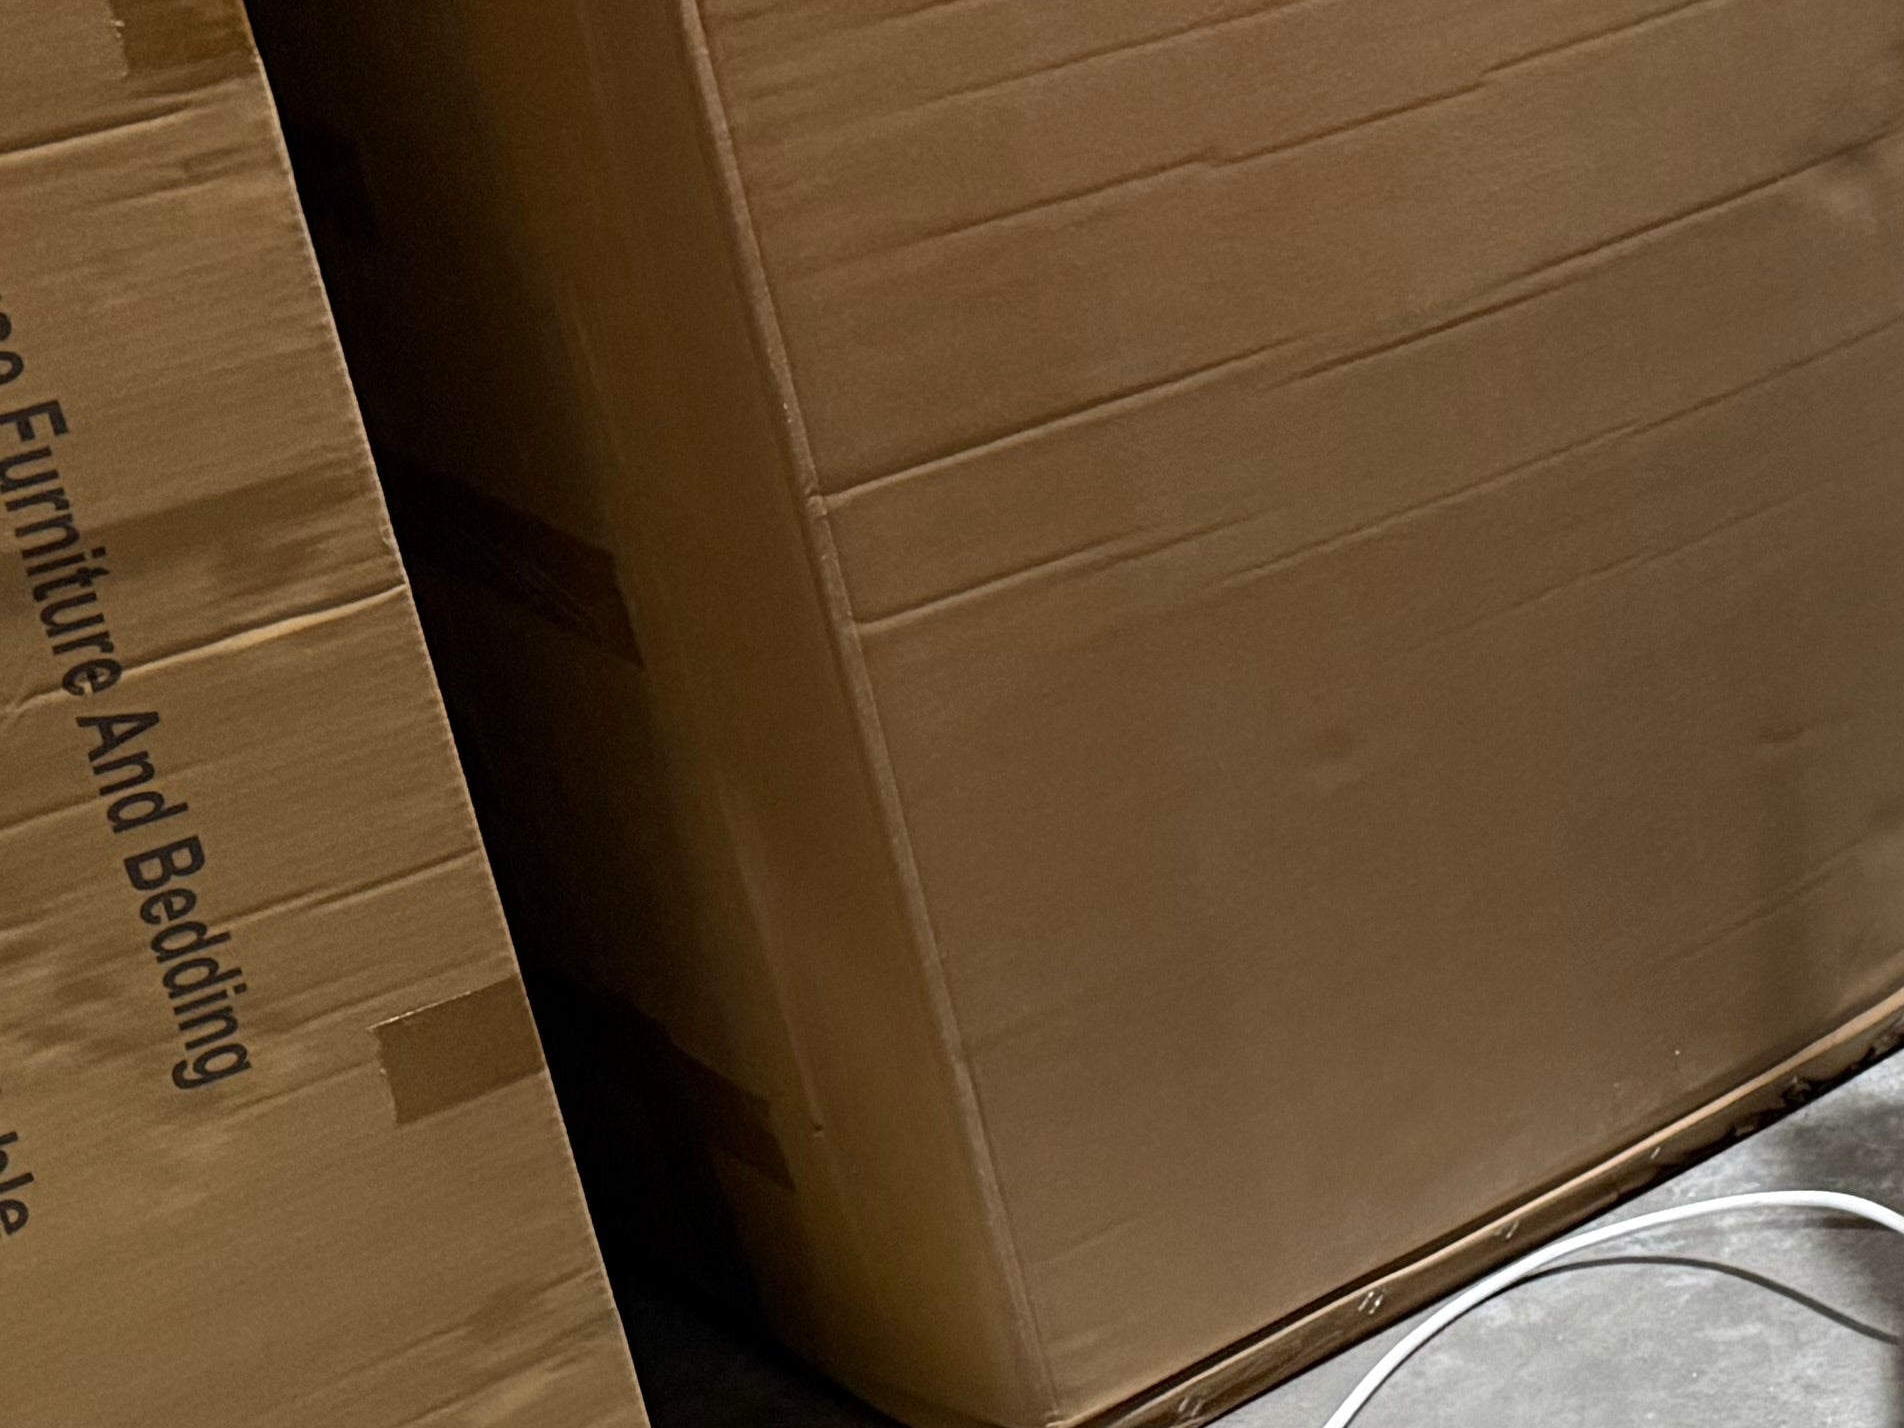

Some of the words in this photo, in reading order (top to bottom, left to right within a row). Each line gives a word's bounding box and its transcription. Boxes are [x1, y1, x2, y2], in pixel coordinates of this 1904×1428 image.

[0, 399, 124, 696] Furniture
[76, 711, 189, 834] And
[123, 834, 254, 1090] Bedding
